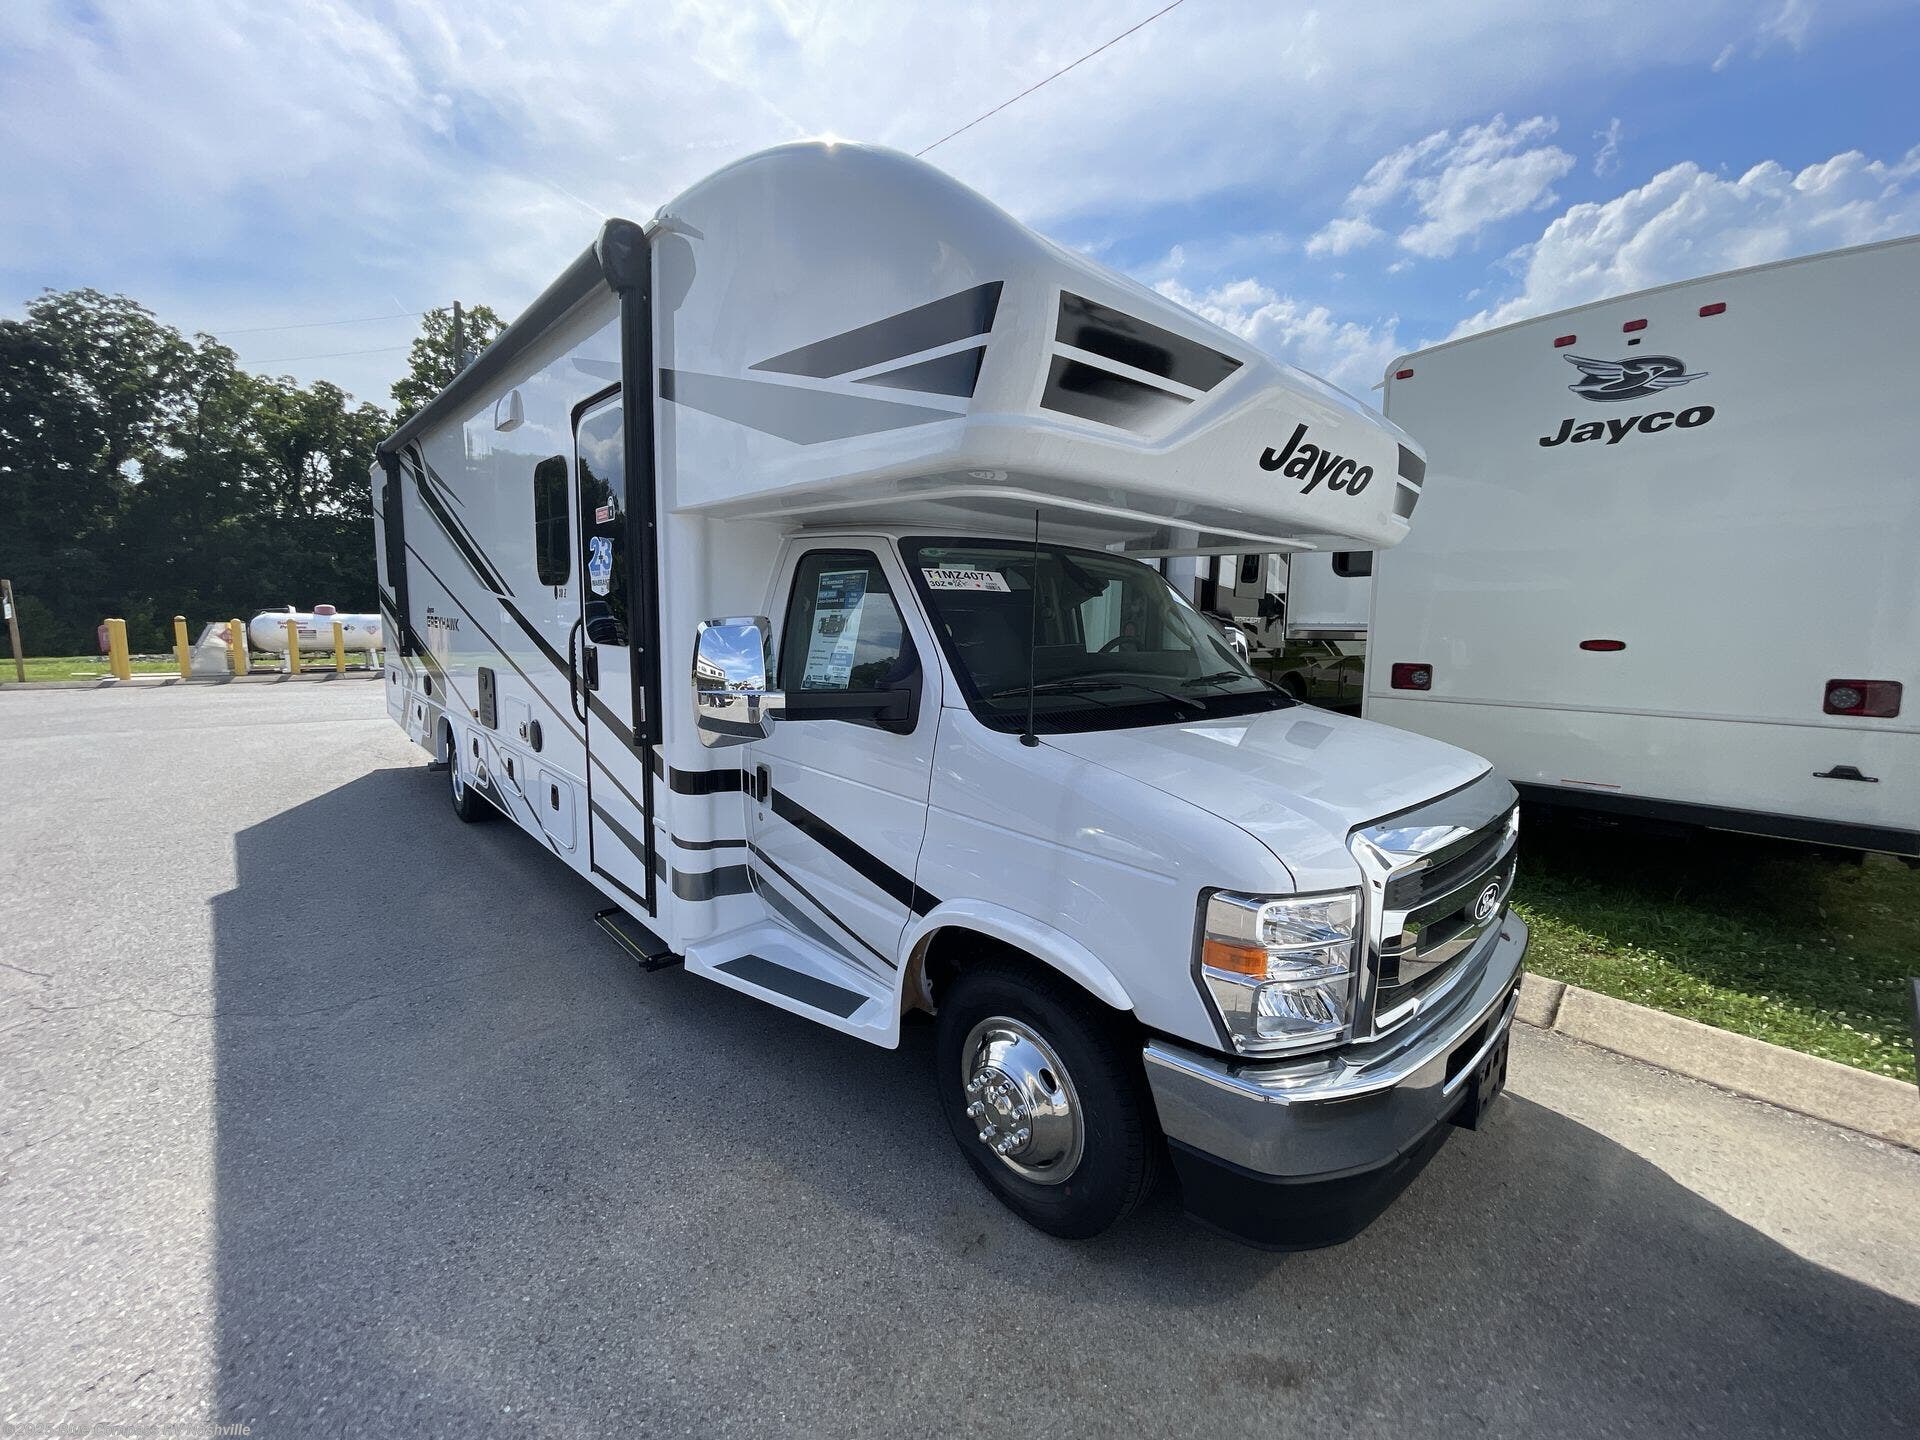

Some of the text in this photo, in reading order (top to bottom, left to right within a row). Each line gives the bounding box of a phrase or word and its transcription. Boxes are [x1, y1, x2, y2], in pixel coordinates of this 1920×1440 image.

[1539, 405, 1715, 447] Jayco
[1259, 422, 1374, 496] Jayco
[923, 569, 993, 581] T1MZ4071
[1479, 888, 1496, 916] Ford
